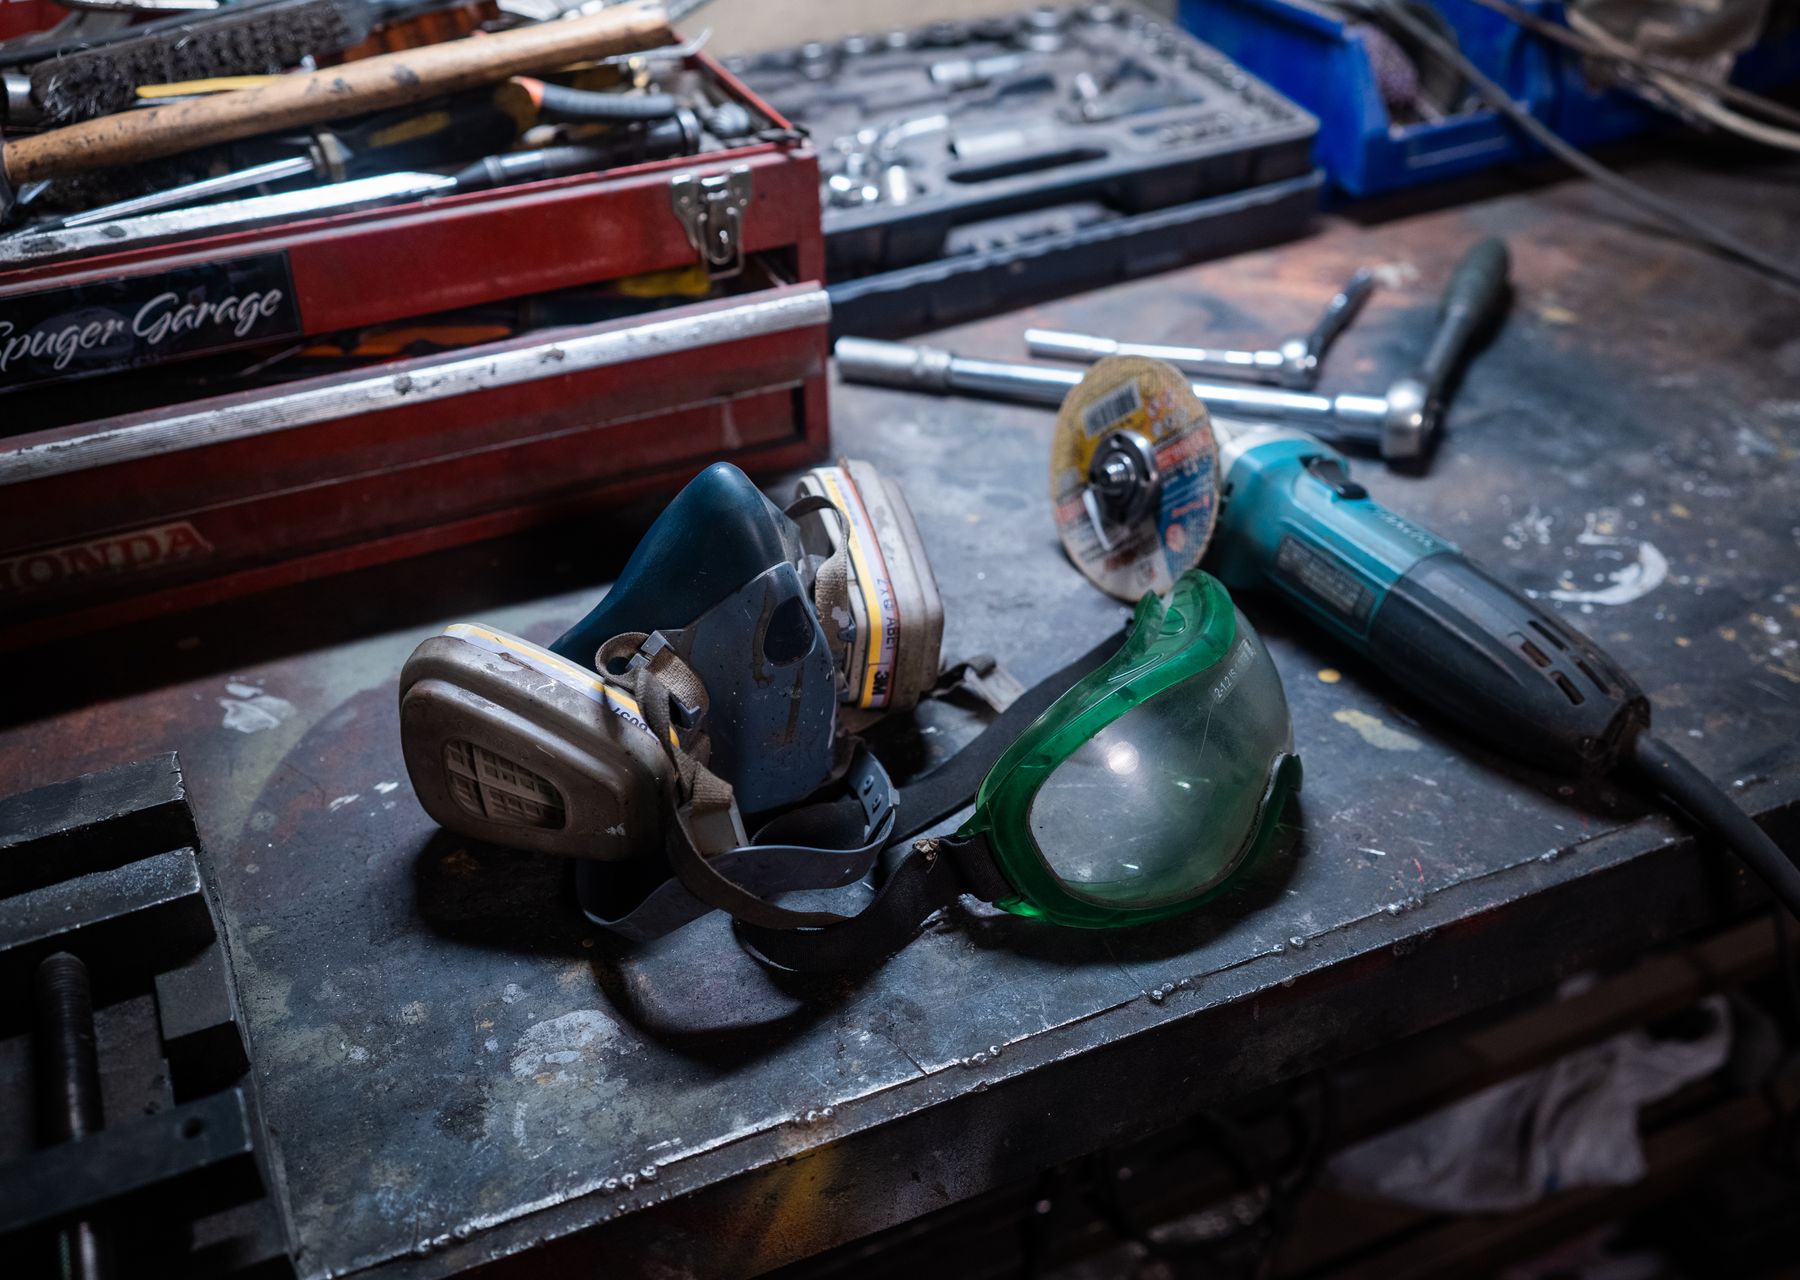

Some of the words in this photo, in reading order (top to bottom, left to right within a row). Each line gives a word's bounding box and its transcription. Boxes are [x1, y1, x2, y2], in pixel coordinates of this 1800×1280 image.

[132, 289, 282, 344] Garage
[0, 525, 203, 592] ONDA
[872, 669, 890, 696] 3M
